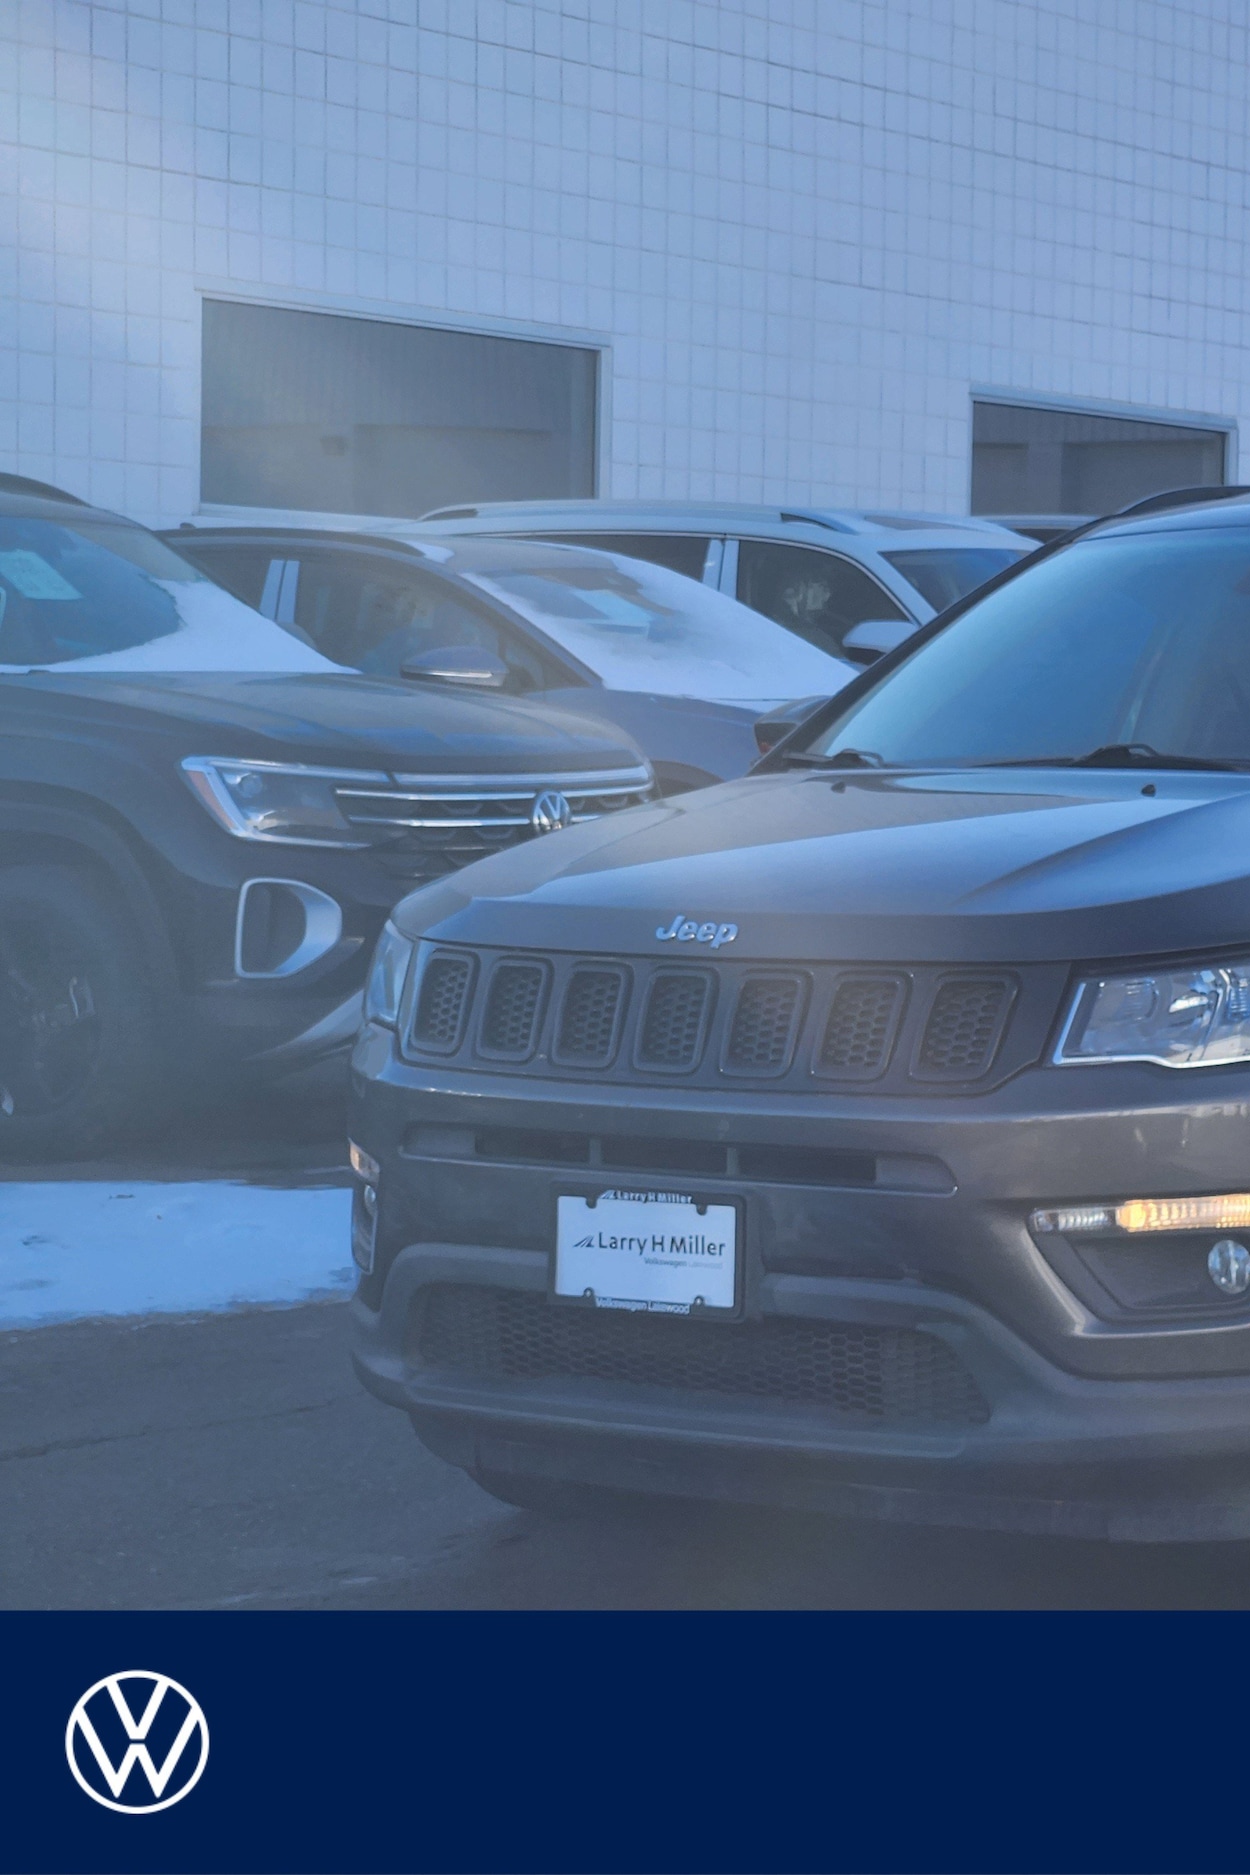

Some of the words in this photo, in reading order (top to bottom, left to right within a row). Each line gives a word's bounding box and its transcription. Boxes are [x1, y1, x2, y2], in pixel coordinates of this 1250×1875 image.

[655, 915, 738, 950] Jeep
[617, 1190, 647, 1203] Larry
[648, 1192, 656, 1202] H
[657, 1192, 692, 1204] Miller
[598, 1232, 647, 1256] Larry
[652, 1235, 665, 1253] H
[669, 1235, 726, 1257] Miller
[644, 1256, 687, 1269] Volkswagen
